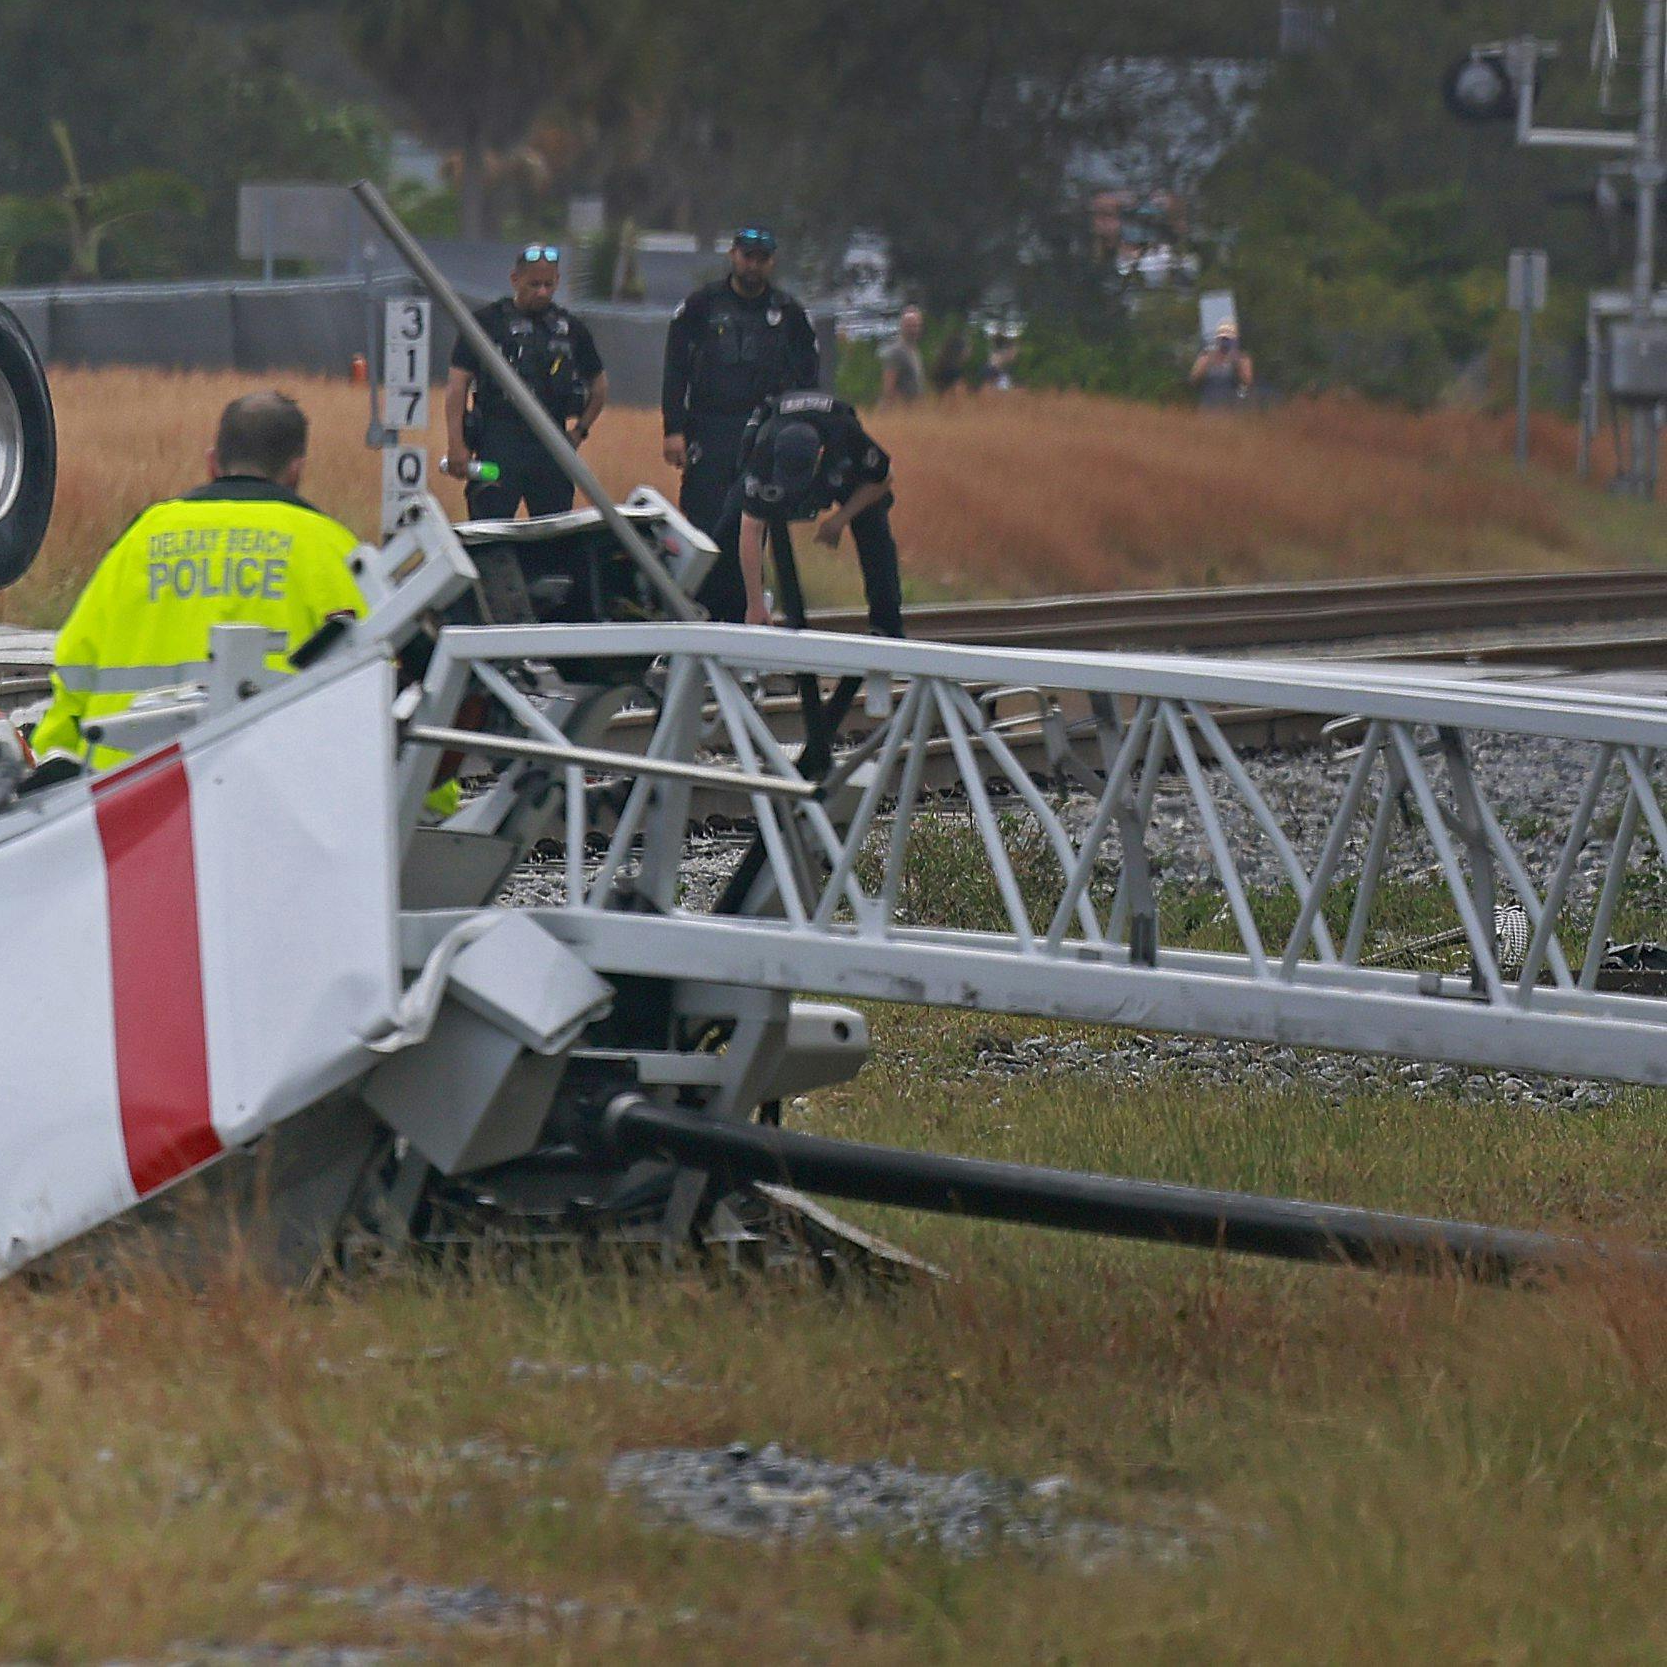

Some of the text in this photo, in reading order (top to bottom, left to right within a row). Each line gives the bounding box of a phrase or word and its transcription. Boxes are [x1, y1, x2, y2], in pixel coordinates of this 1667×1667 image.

[149, 528, 293, 559] DELRAY BEACH
[148, 557, 288, 603] POLICE
